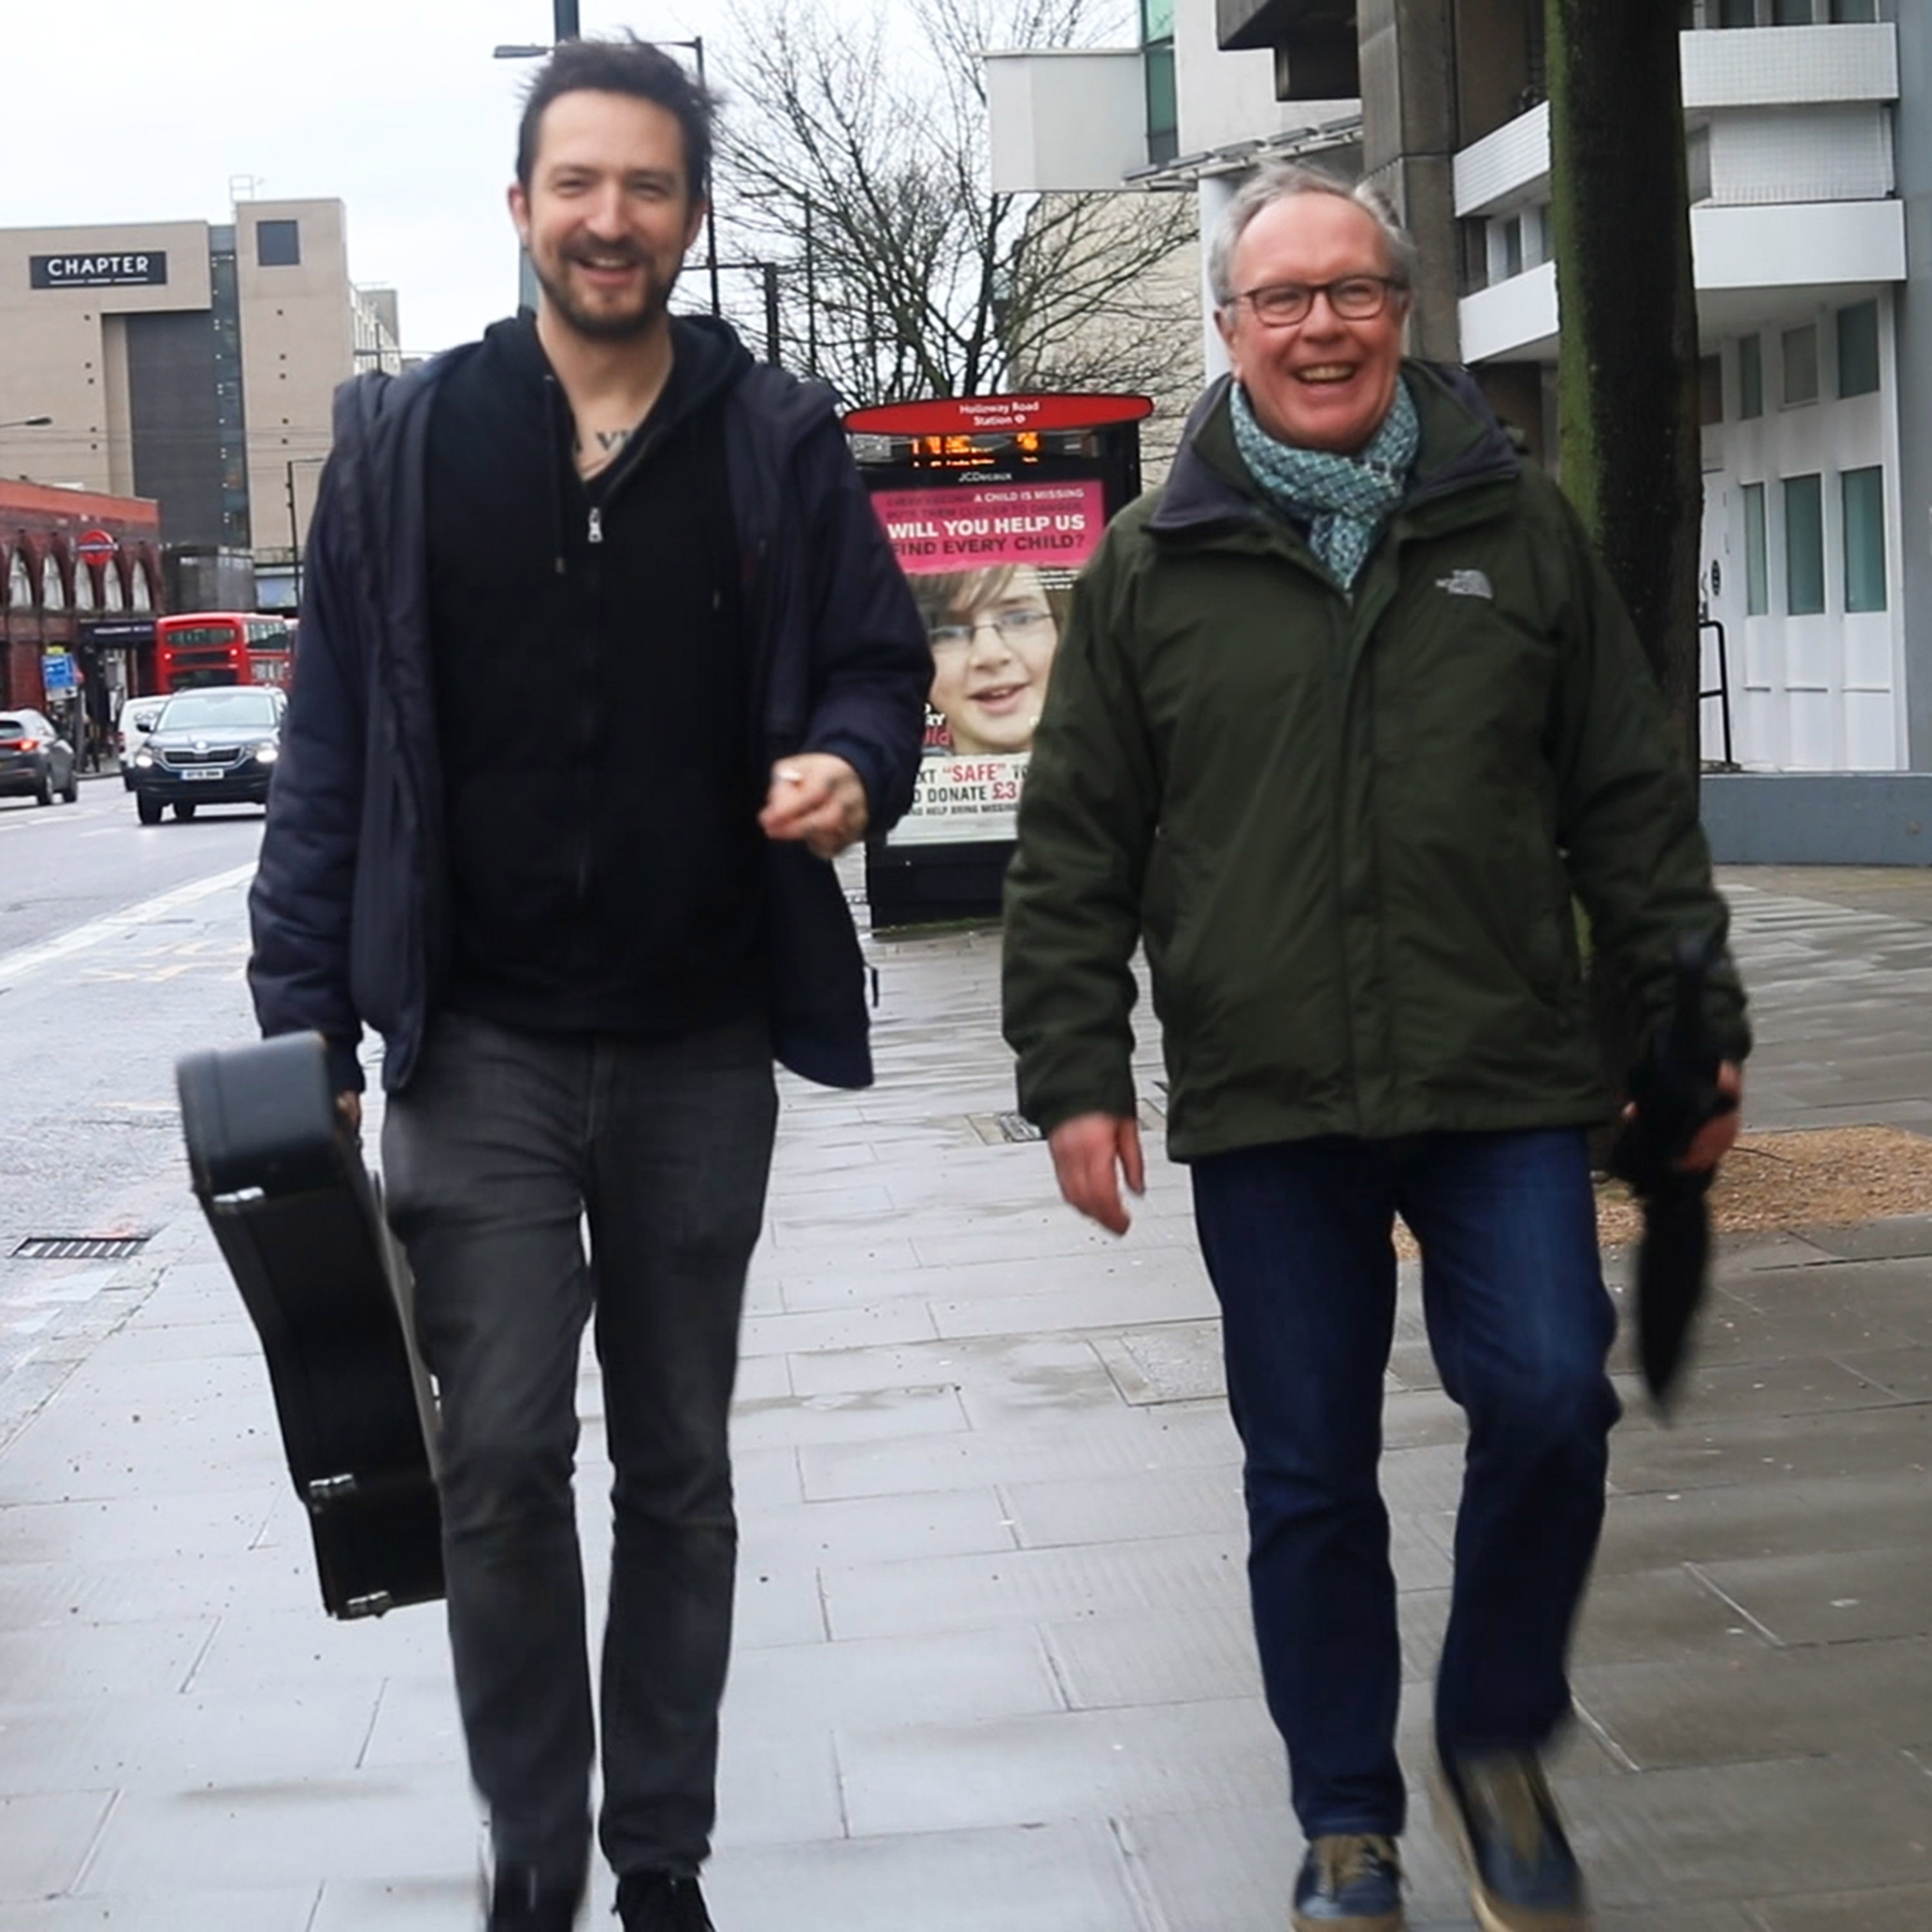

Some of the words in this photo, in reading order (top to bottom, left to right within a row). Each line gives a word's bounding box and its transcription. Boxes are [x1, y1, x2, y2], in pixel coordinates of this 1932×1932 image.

[48, 256, 148, 276] CHAPTER
[959, 403, 1010, 415] Holloway
[1012, 401, 1040, 412] Road
[973, 415, 1013, 426] Station
[958, 471, 1012, 482] JCDecaux
[974, 494, 983, 502] A
[984, 491, 1018, 502] CHILD
[1020, 491, 1032, 500] IS
[1034, 488, 1084, 500] MISSING
[887, 522, 939, 539] WILL
[943, 518, 989, 536] YOU
[994, 516, 1050, 534] HELP
[1054, 514, 1085, 531] US
[943, 537, 1007, 554] EVERY
[1014, 534, 1085, 551] CHILD?
[927, 785, 987, 803] DONATE
[992, 781, 1016, 800] £3
[926, 806, 947, 816] HELP
[951, 805, 978, 815] BRING
